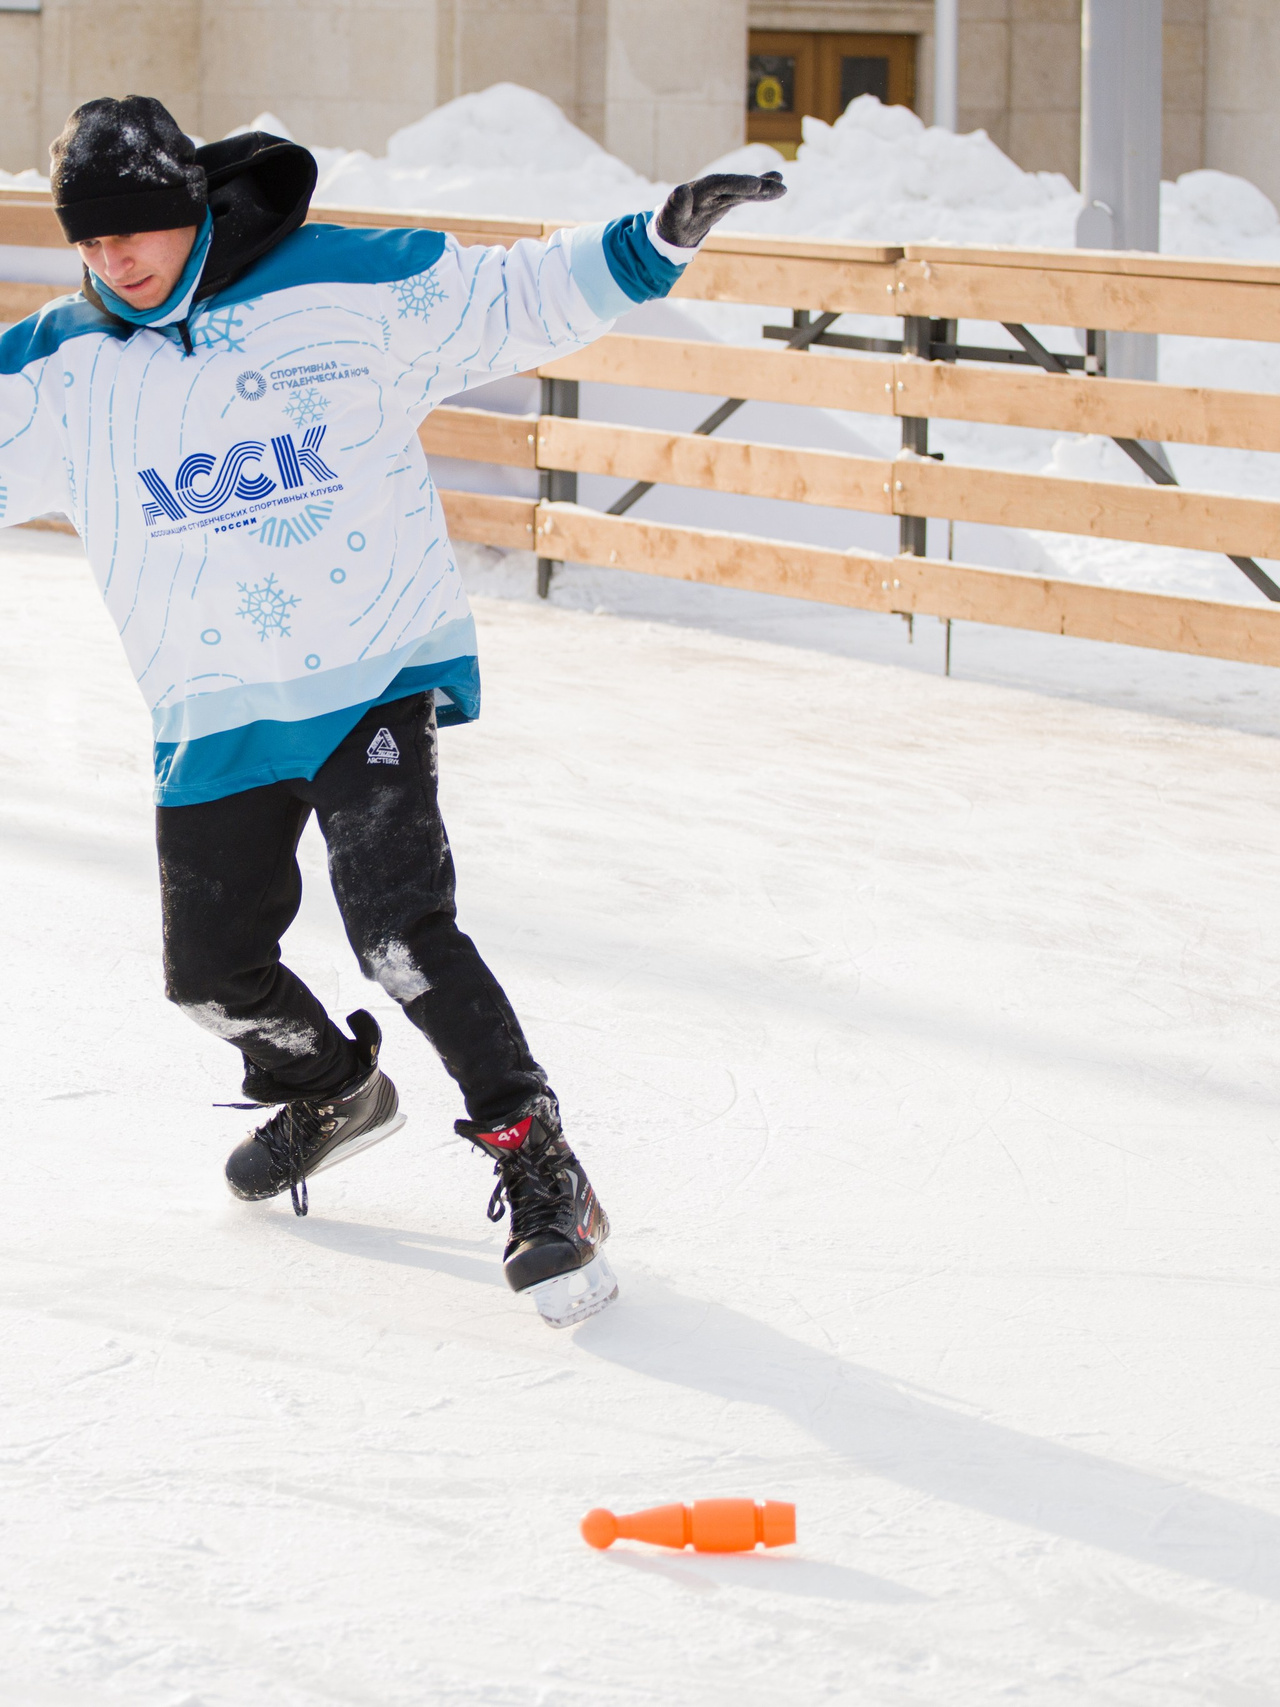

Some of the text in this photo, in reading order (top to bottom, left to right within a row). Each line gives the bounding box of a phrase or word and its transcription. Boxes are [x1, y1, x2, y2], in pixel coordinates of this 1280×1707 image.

[270, 361, 337, 379] СПОРТИВНАЯ
[272, 367, 369, 390] СТУДЕНЧЕСКАЯ НОЧЬ
[188, 508, 248, 530] СТУДЕНЧЕСКИХ
[249, 493, 308, 513] СПОРТИВНЫХ
[310, 484, 344, 497] КЛУБОВ
[214, 517, 257, 534] РОССИИ
[498, 1128, 519, 1141] 41
